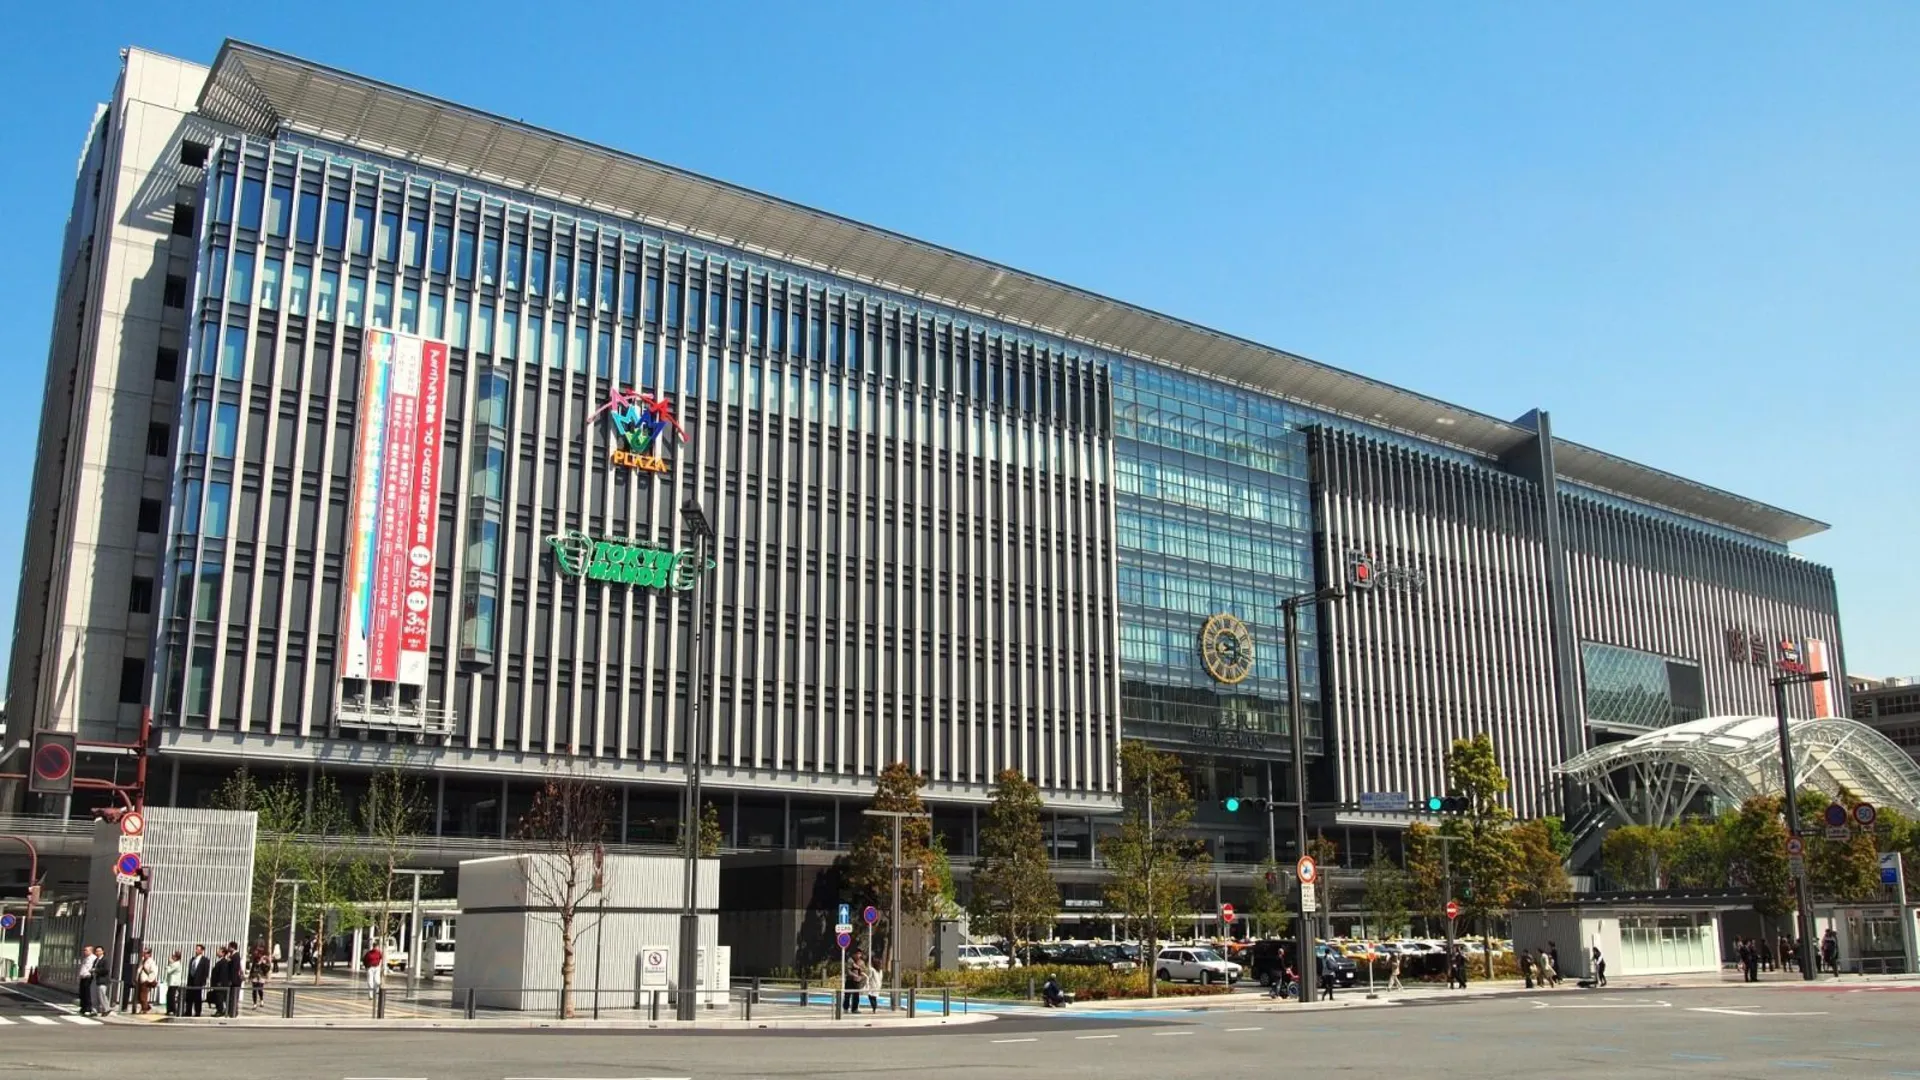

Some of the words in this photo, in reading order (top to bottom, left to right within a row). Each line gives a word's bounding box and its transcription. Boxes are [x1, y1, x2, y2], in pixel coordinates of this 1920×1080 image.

[612, 450, 667, 473] PLAZA
[593, 541, 674, 569] TOKYU
[410, 567, 428, 580] 5%
[409, 579, 428, 589] OFF
[406, 612, 425, 626] 3%
